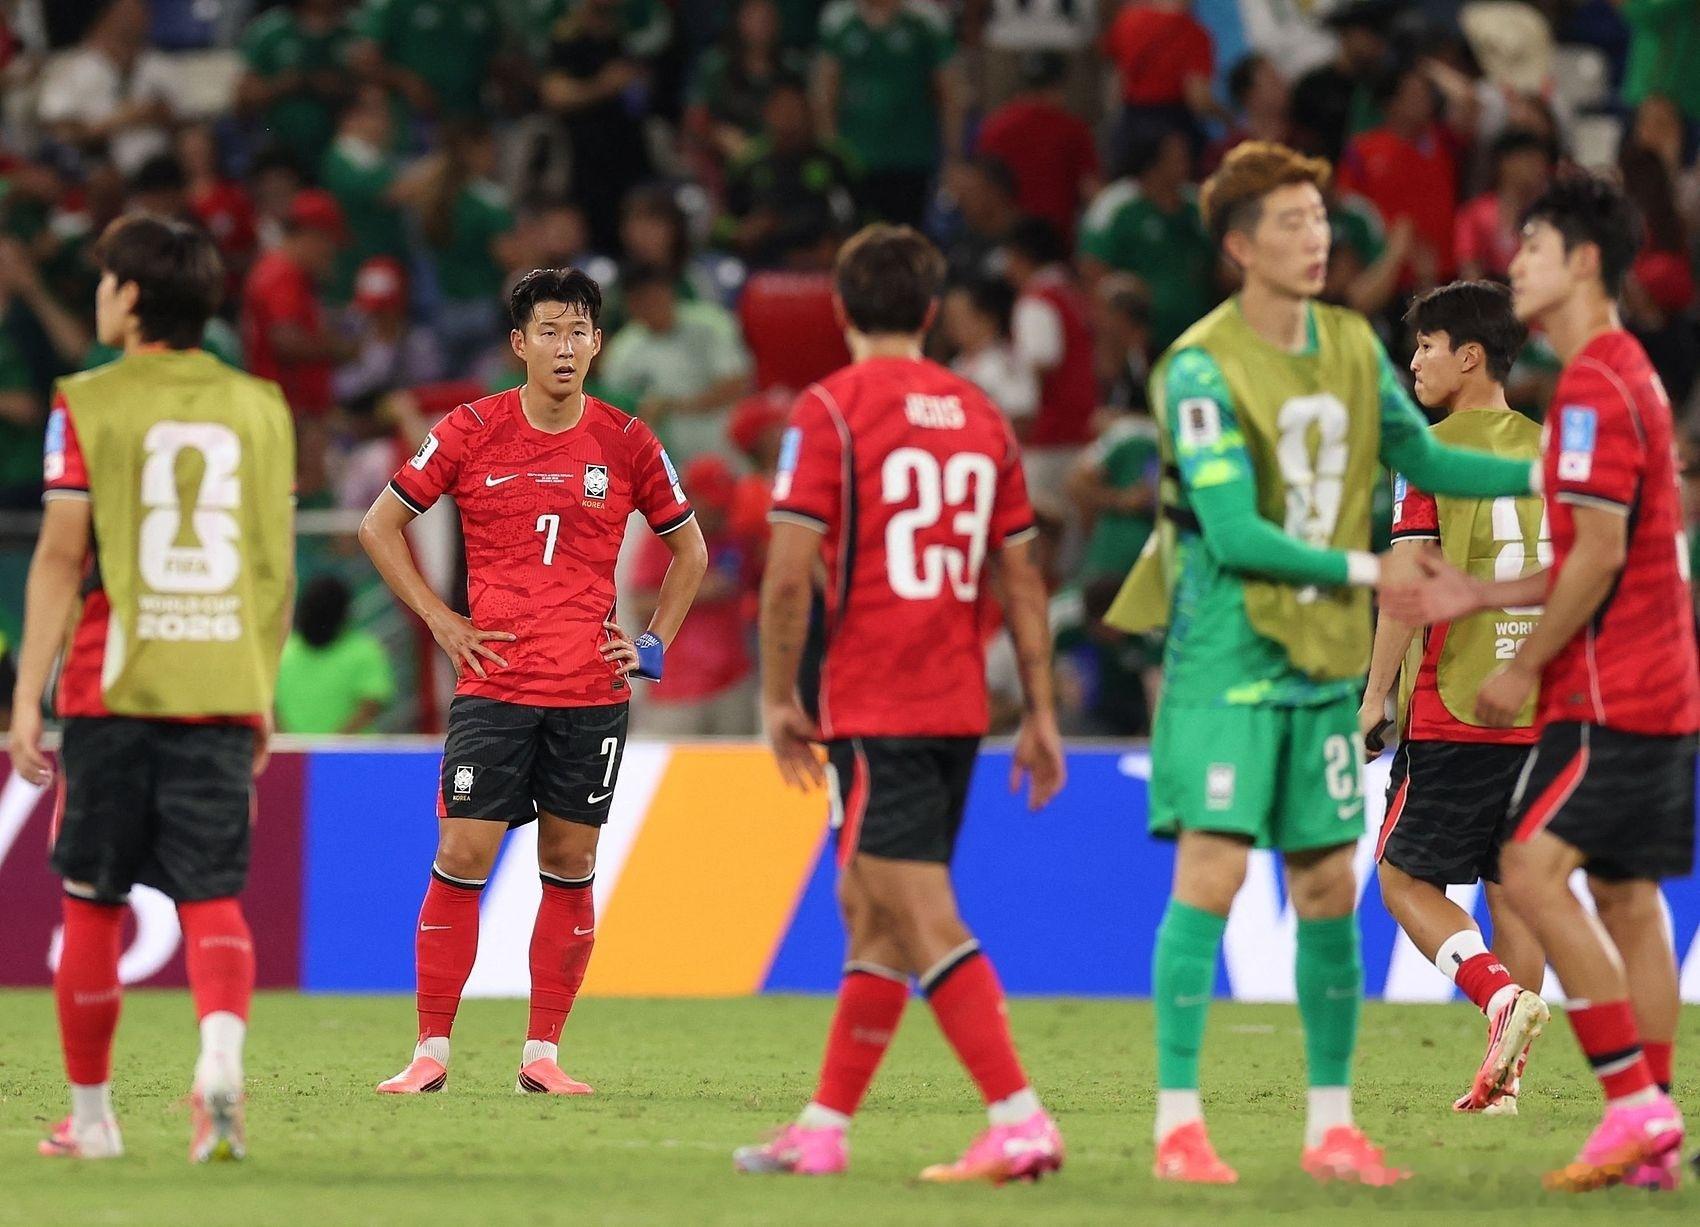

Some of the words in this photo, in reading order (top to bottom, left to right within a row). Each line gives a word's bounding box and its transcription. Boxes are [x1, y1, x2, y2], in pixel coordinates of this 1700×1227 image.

[581, 499, 606, 510] KOREA
[881, 446, 998, 602] 23
[535, 514, 560, 566] 7
[138, 595, 199, 611] WORLD
[136, 613, 242, 641] 2026
[600, 737, 618, 788] 7
[452, 794, 471, 802] KOREA
